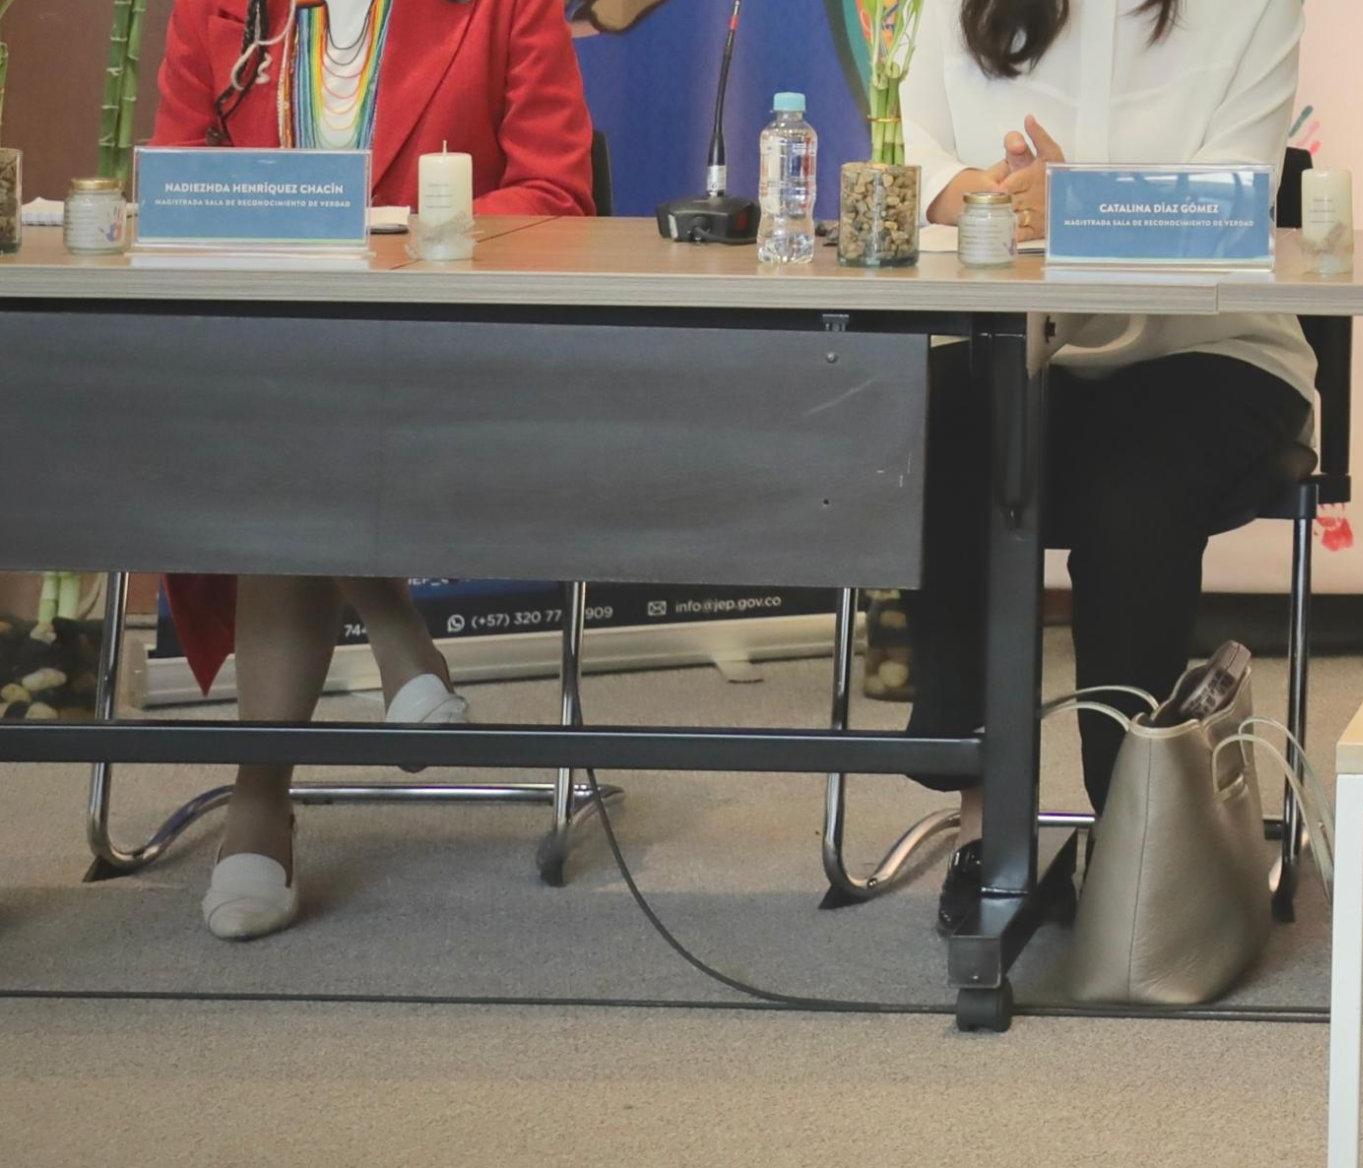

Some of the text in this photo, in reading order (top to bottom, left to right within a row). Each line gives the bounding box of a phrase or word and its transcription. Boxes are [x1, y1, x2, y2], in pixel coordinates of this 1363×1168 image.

[165, 182, 344, 195] NADIEZHDA HENRÍQUEZ CHACÍN
[1099, 202, 1219, 214] CATALINA DÍAZ GÓMEZ
[471, 606, 613, 629] (+57) 320 77 909
